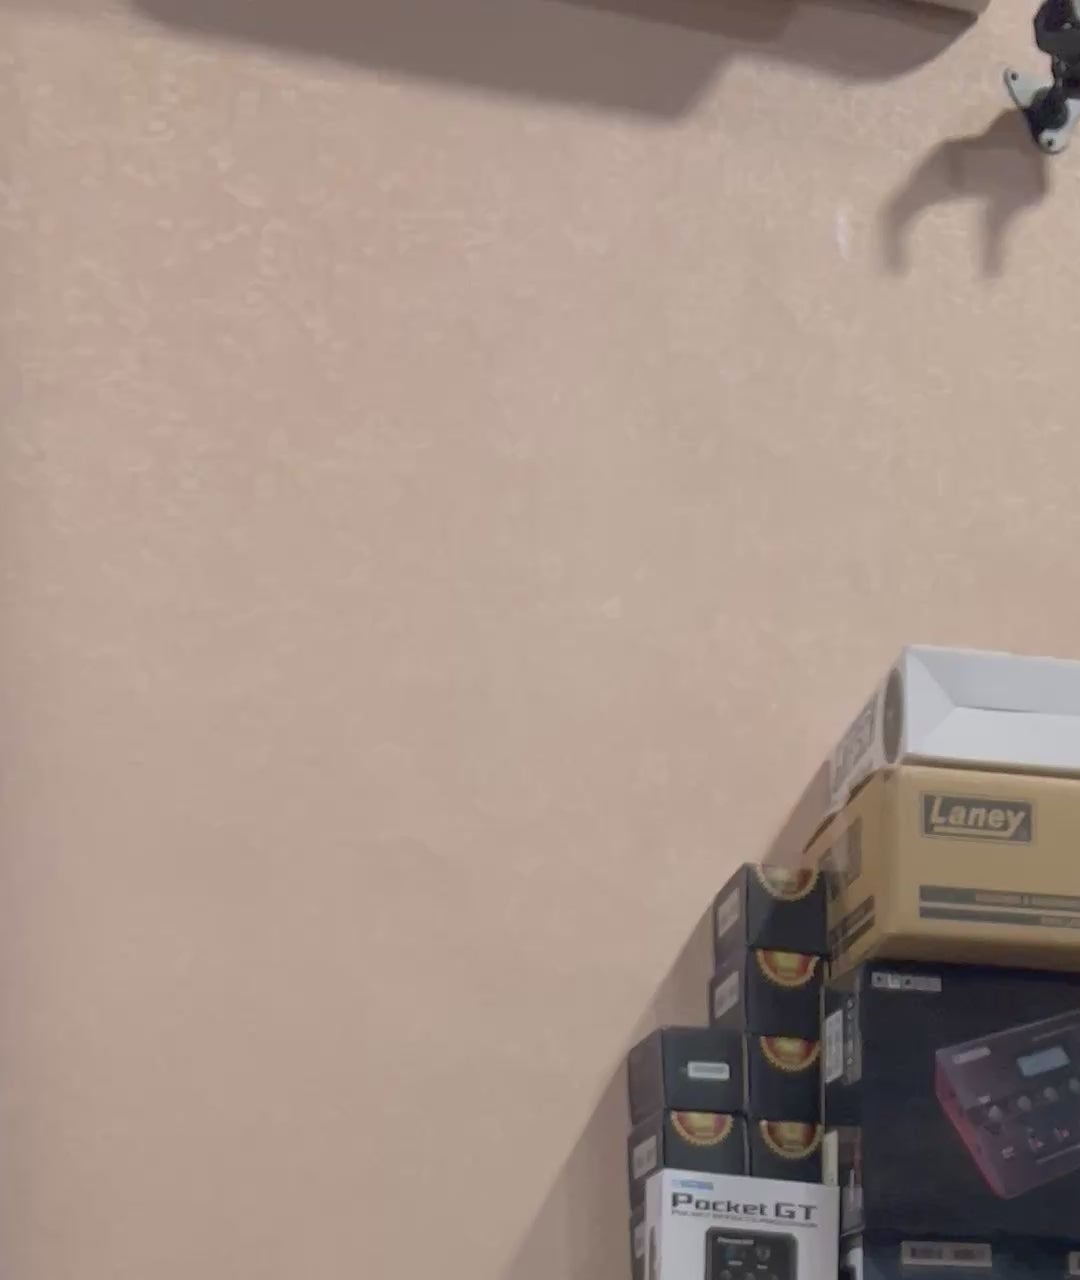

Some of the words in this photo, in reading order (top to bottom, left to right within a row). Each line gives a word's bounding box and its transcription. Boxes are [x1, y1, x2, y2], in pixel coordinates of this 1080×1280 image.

[930, 796, 1027, 838] Laney
[671, 1191, 768, 1217] Pocket
[774, 1202, 818, 1221] GT
